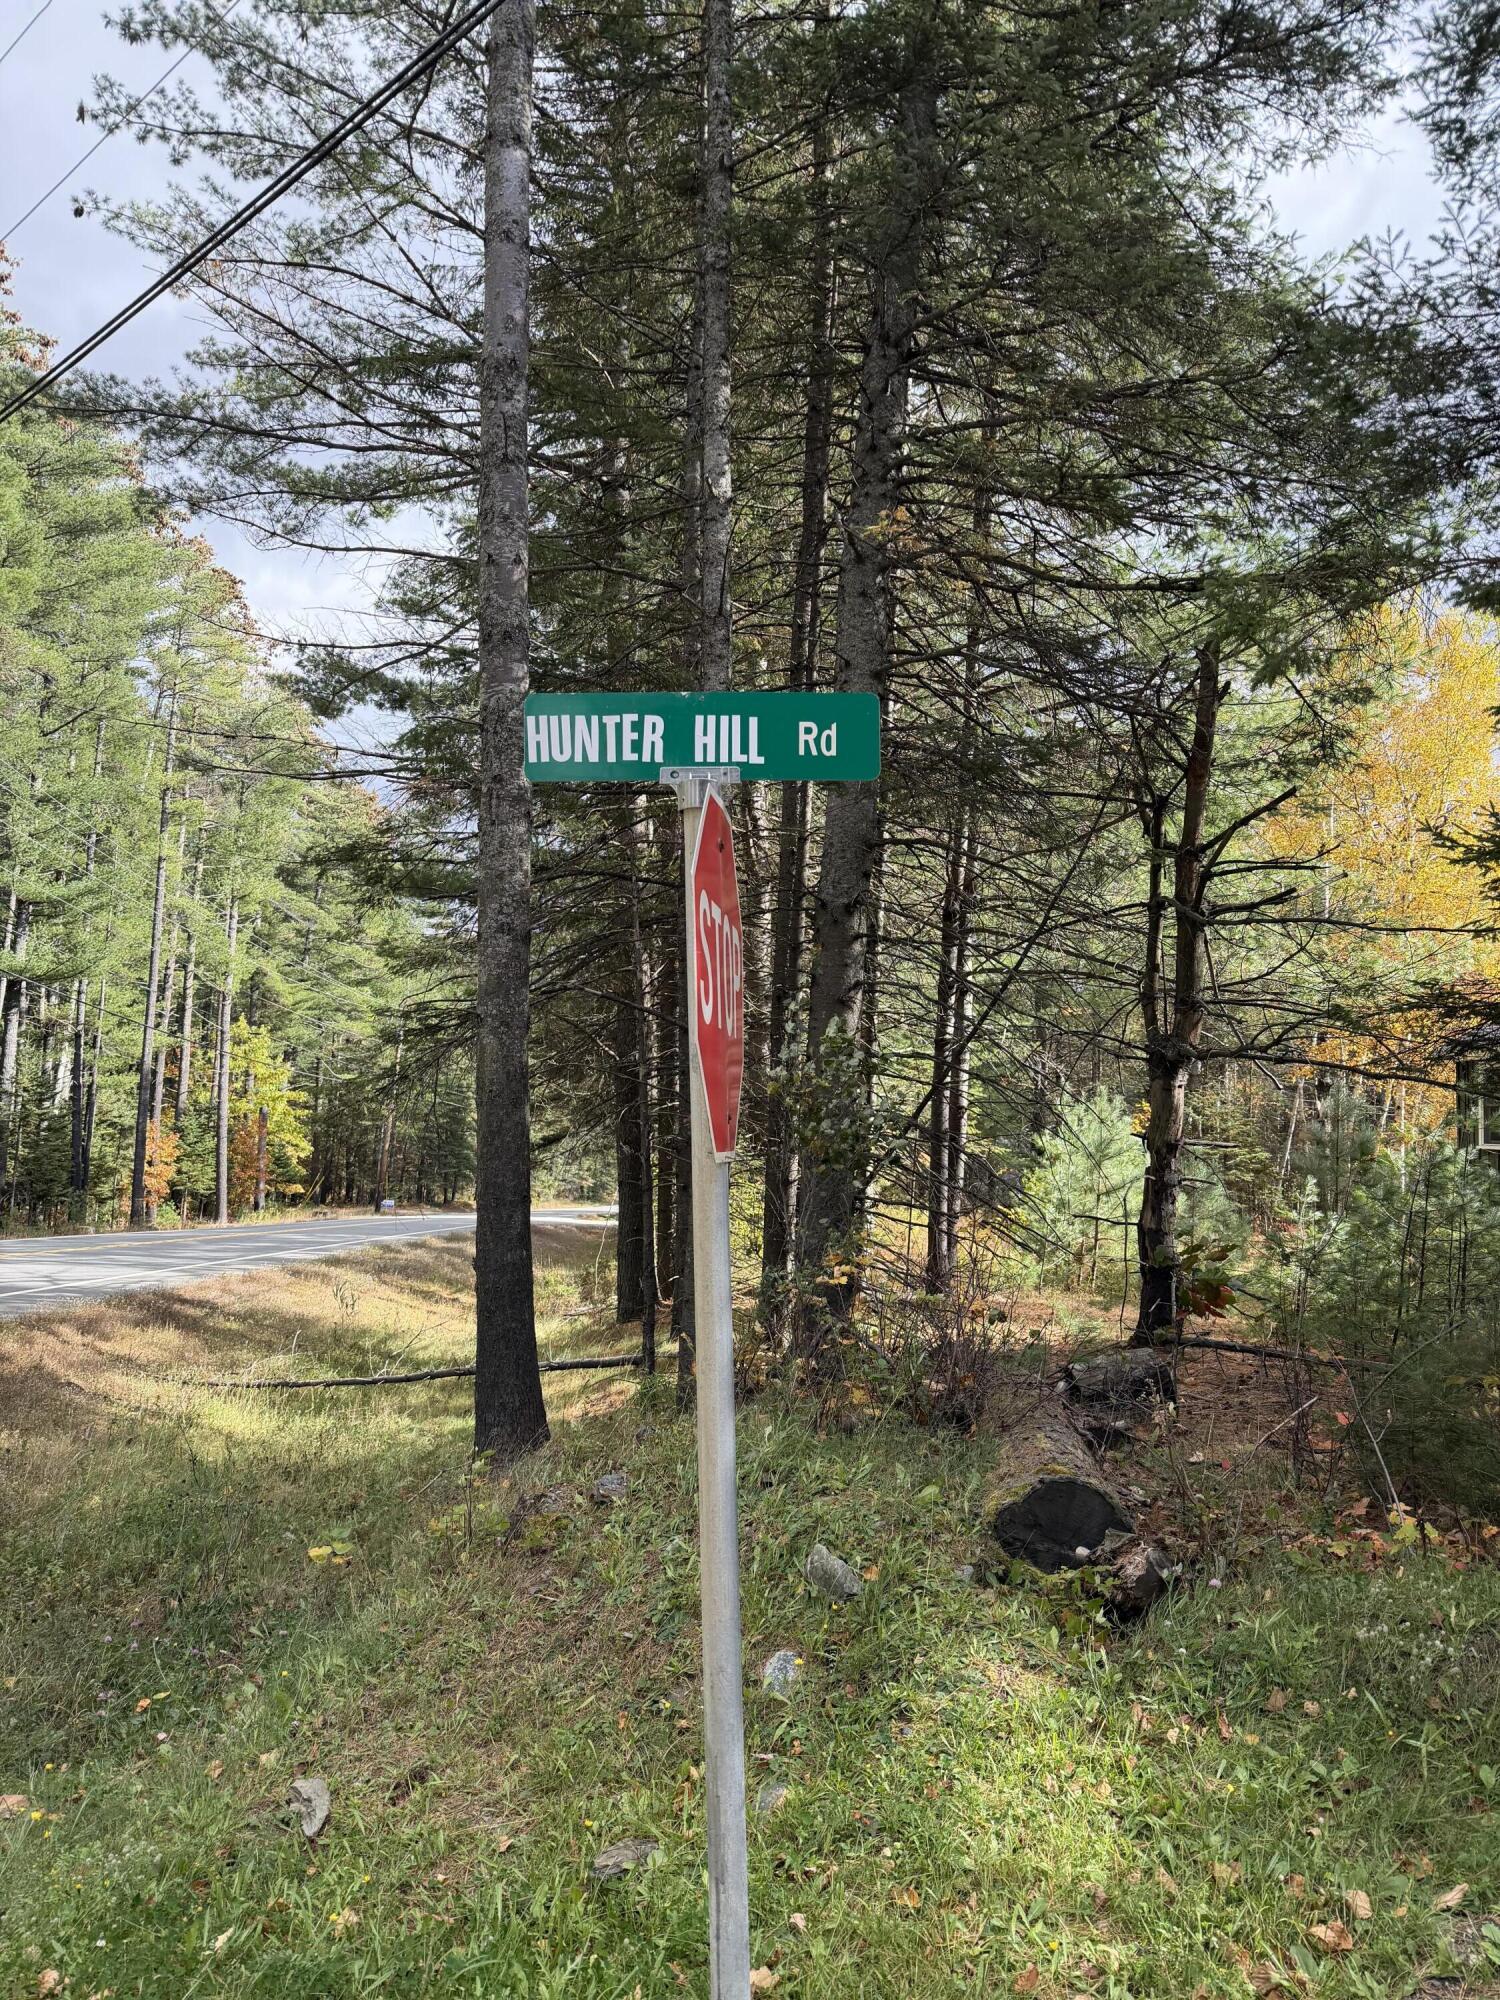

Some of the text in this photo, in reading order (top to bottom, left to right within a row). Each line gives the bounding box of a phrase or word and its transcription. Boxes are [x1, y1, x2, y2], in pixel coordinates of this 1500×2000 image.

[526, 713, 837, 764] HUNTER HILL Rd
[700, 889, 741, 1039] STOP
